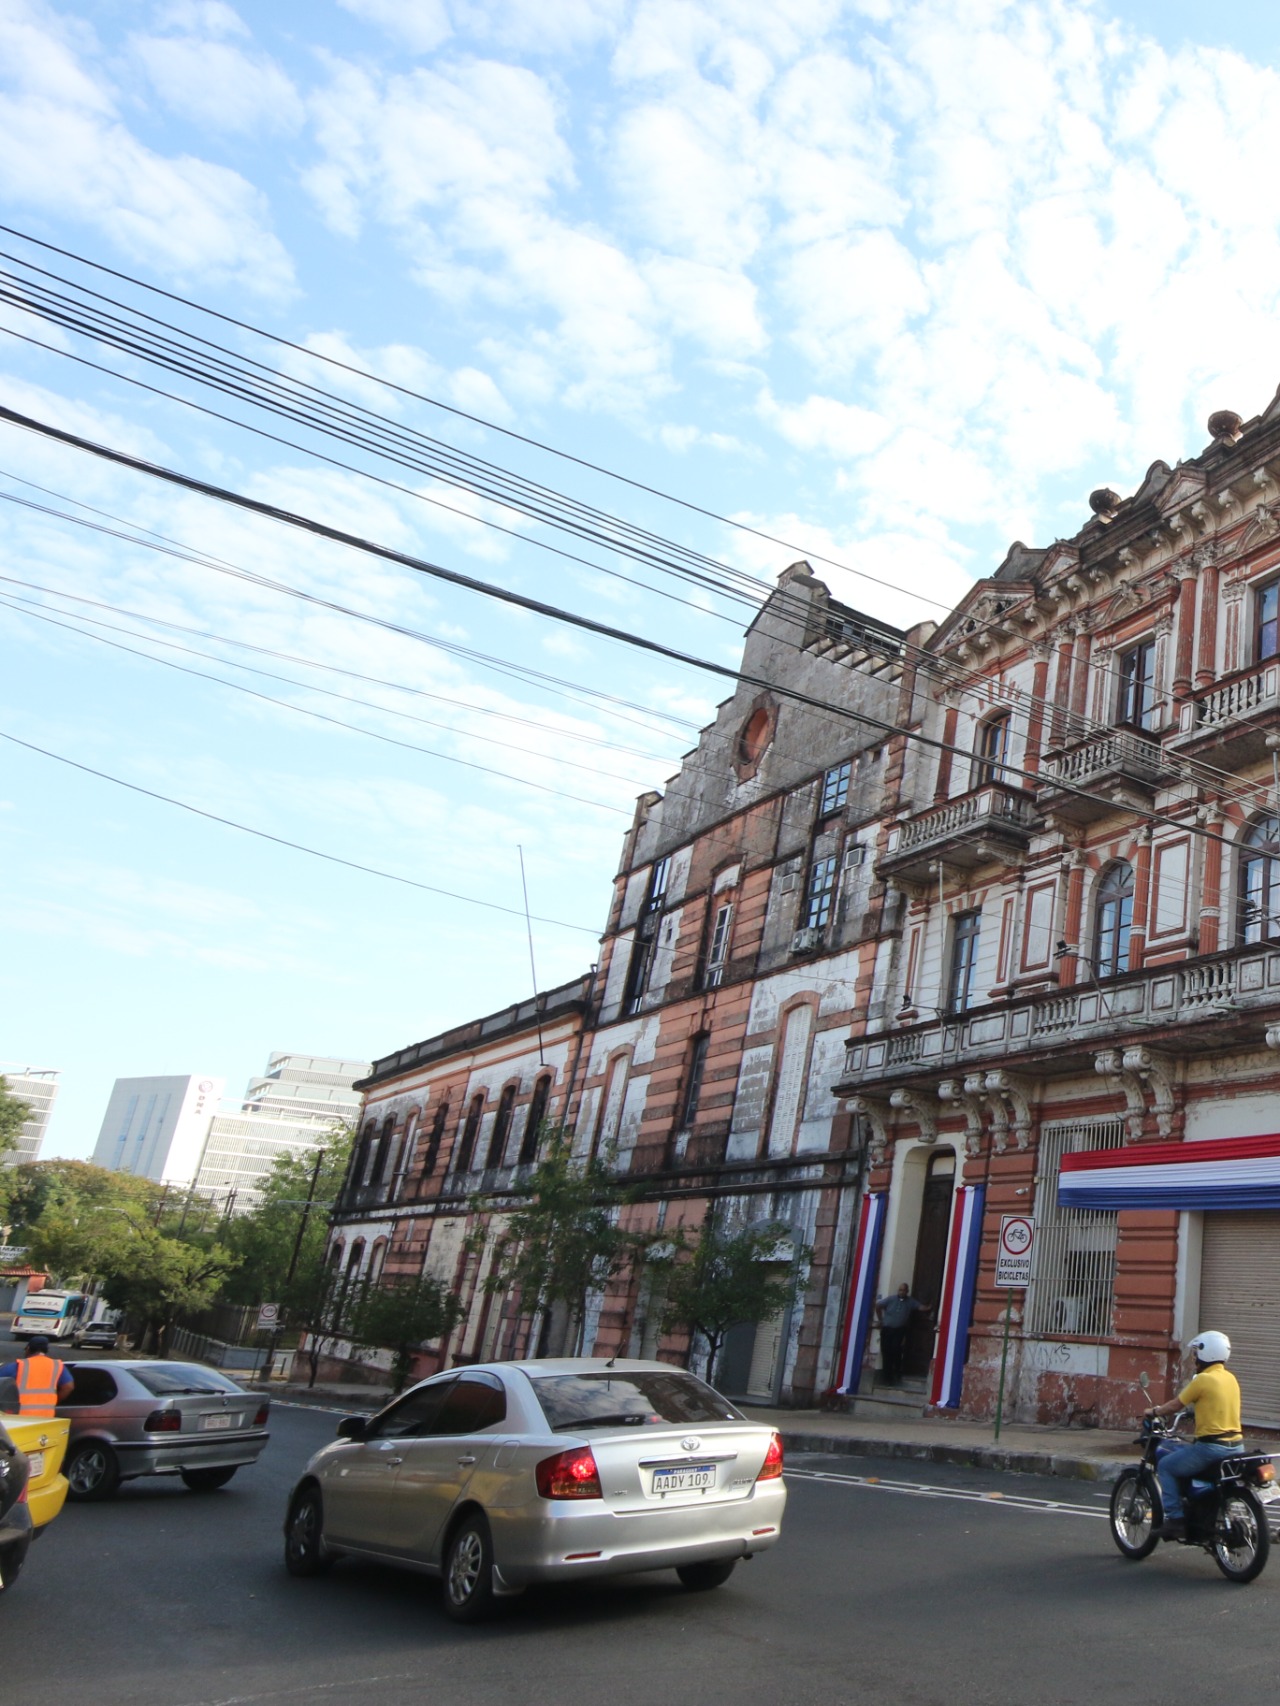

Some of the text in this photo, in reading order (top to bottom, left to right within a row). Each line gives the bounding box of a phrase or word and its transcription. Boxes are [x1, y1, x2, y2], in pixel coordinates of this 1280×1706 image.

[1000, 1258, 1029, 1268] EXCLUSIVO
[998, 1271, 1029, 1281] BICICLETAS
[656, 1473, 709, 1490] AADY 109
